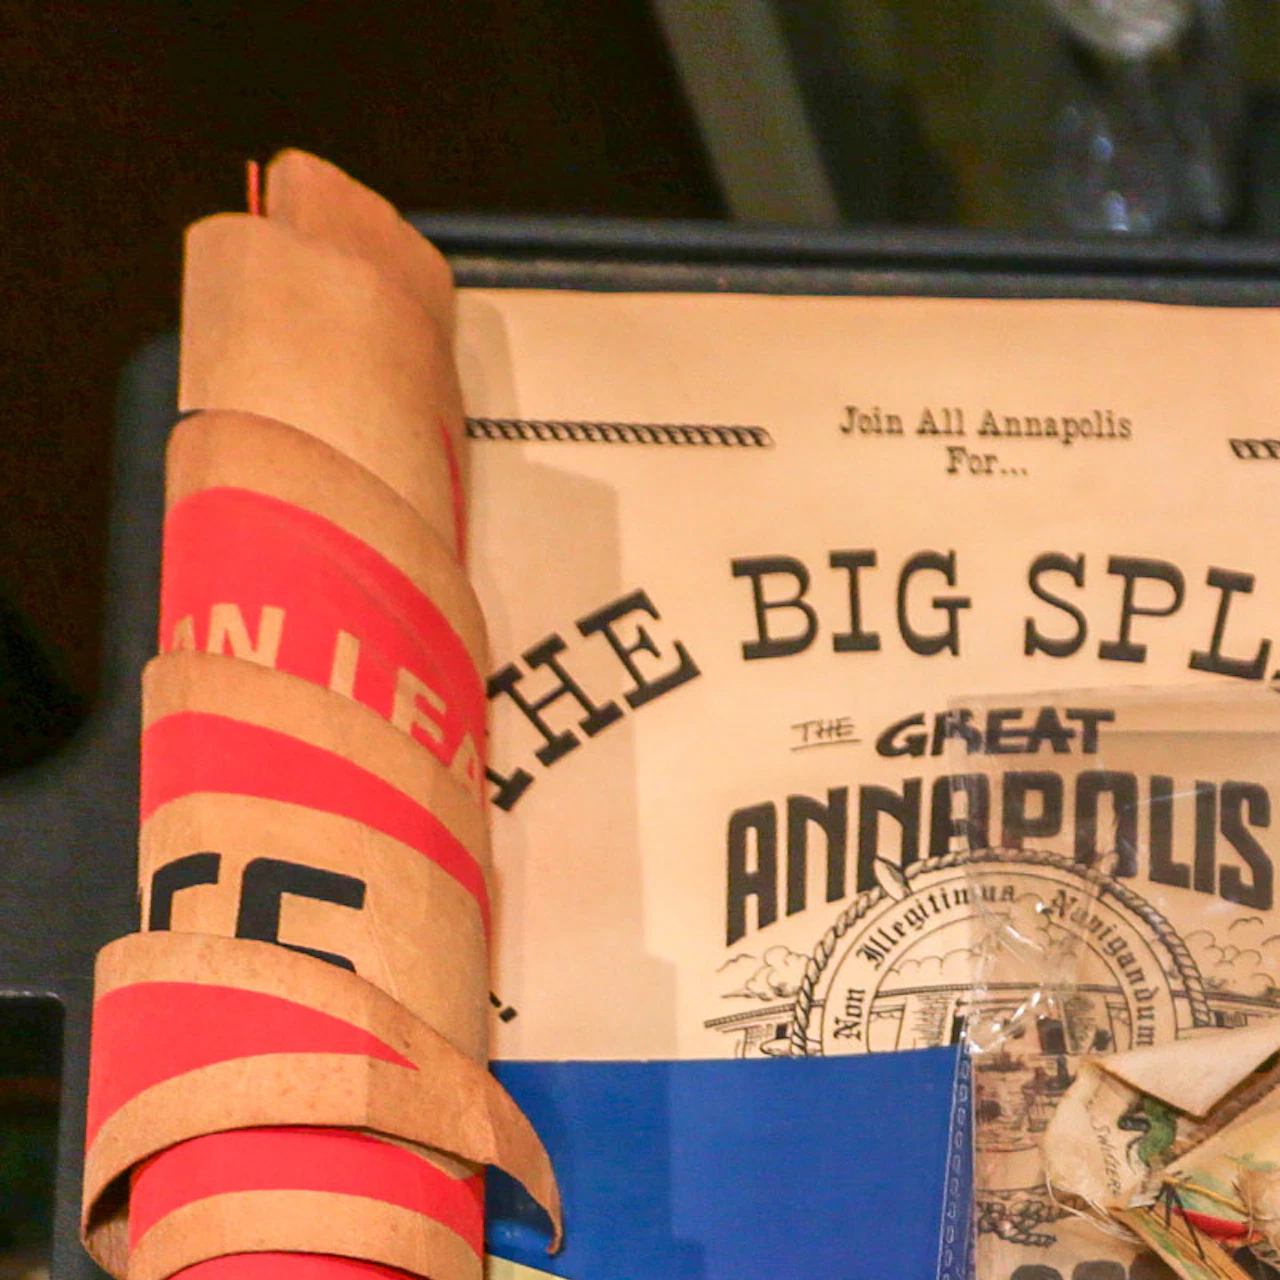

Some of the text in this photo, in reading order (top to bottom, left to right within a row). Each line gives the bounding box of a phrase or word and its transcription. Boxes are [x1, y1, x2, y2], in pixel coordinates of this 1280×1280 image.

[840, 406, 1133, 444] Join All Annapolis
[946, 448, 1029, 478] For...
[731, 549, 972, 661] BIG
[876, 707, 1115, 757] GREAT
[725, 770, 1275, 948] ANNAPOLIS
